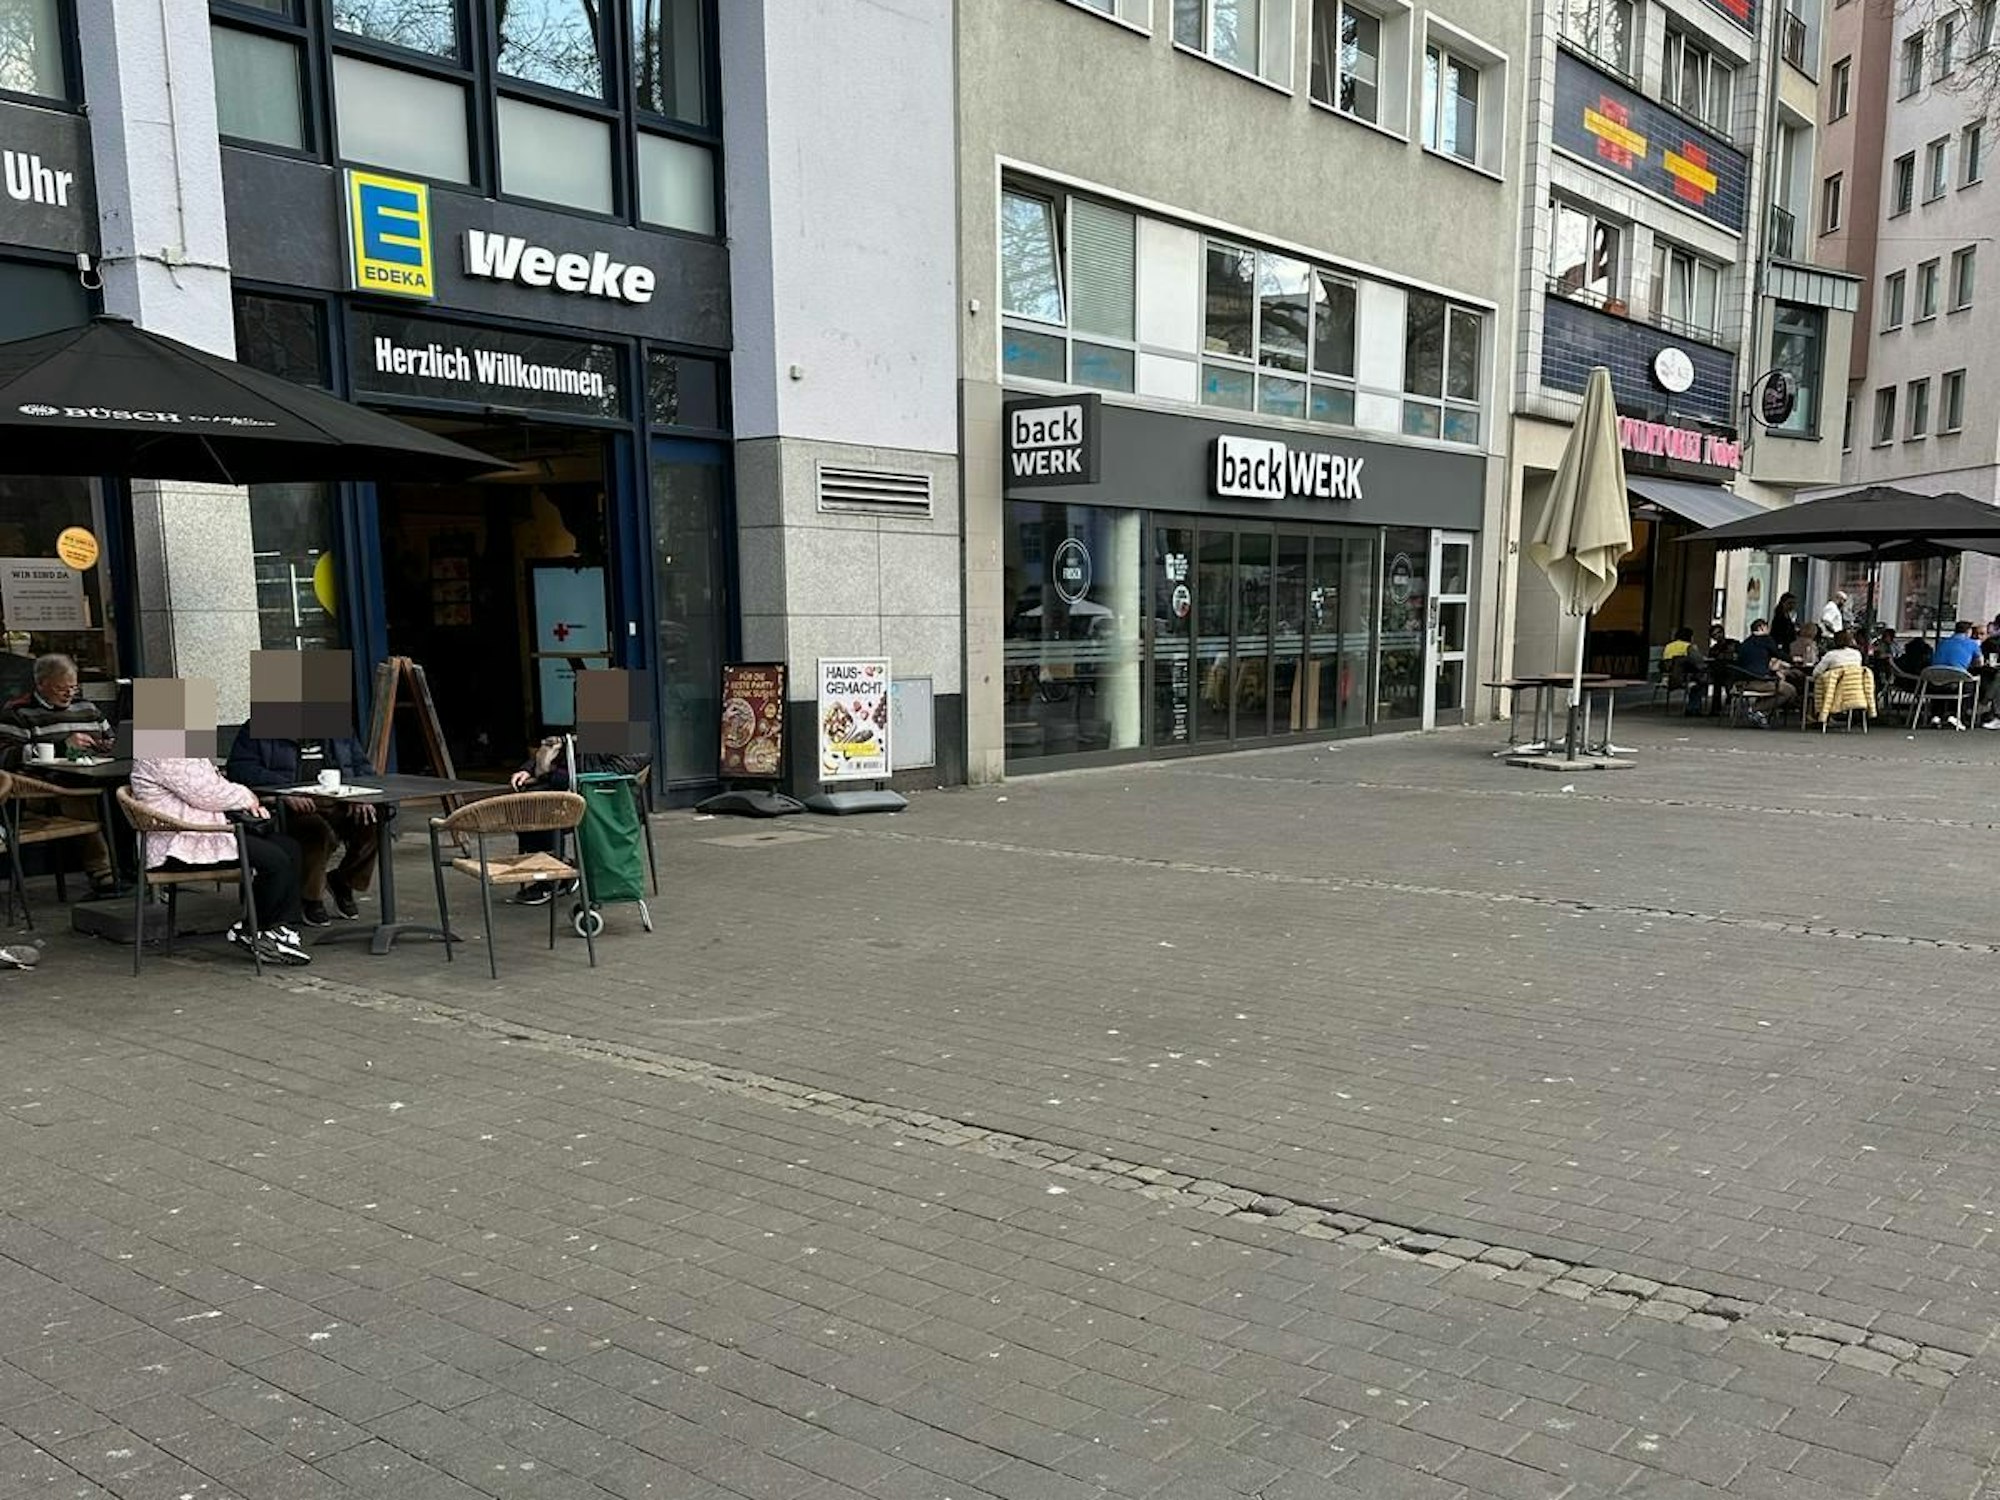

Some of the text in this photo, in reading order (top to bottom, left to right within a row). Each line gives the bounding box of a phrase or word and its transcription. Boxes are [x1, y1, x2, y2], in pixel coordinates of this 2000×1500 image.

[4, 150, 73, 207] Uhr
[364, 265, 426, 288] EDEKA
[464, 229, 656, 303] Weeke
[374, 336, 604, 398] Herzlich Willkommen
[1016, 410, 1078, 444] back
[1011, 448, 1082, 476] WERK
[826, 666, 862, 679] HAUS-
[826, 682, 882, 695] GEMACHT
